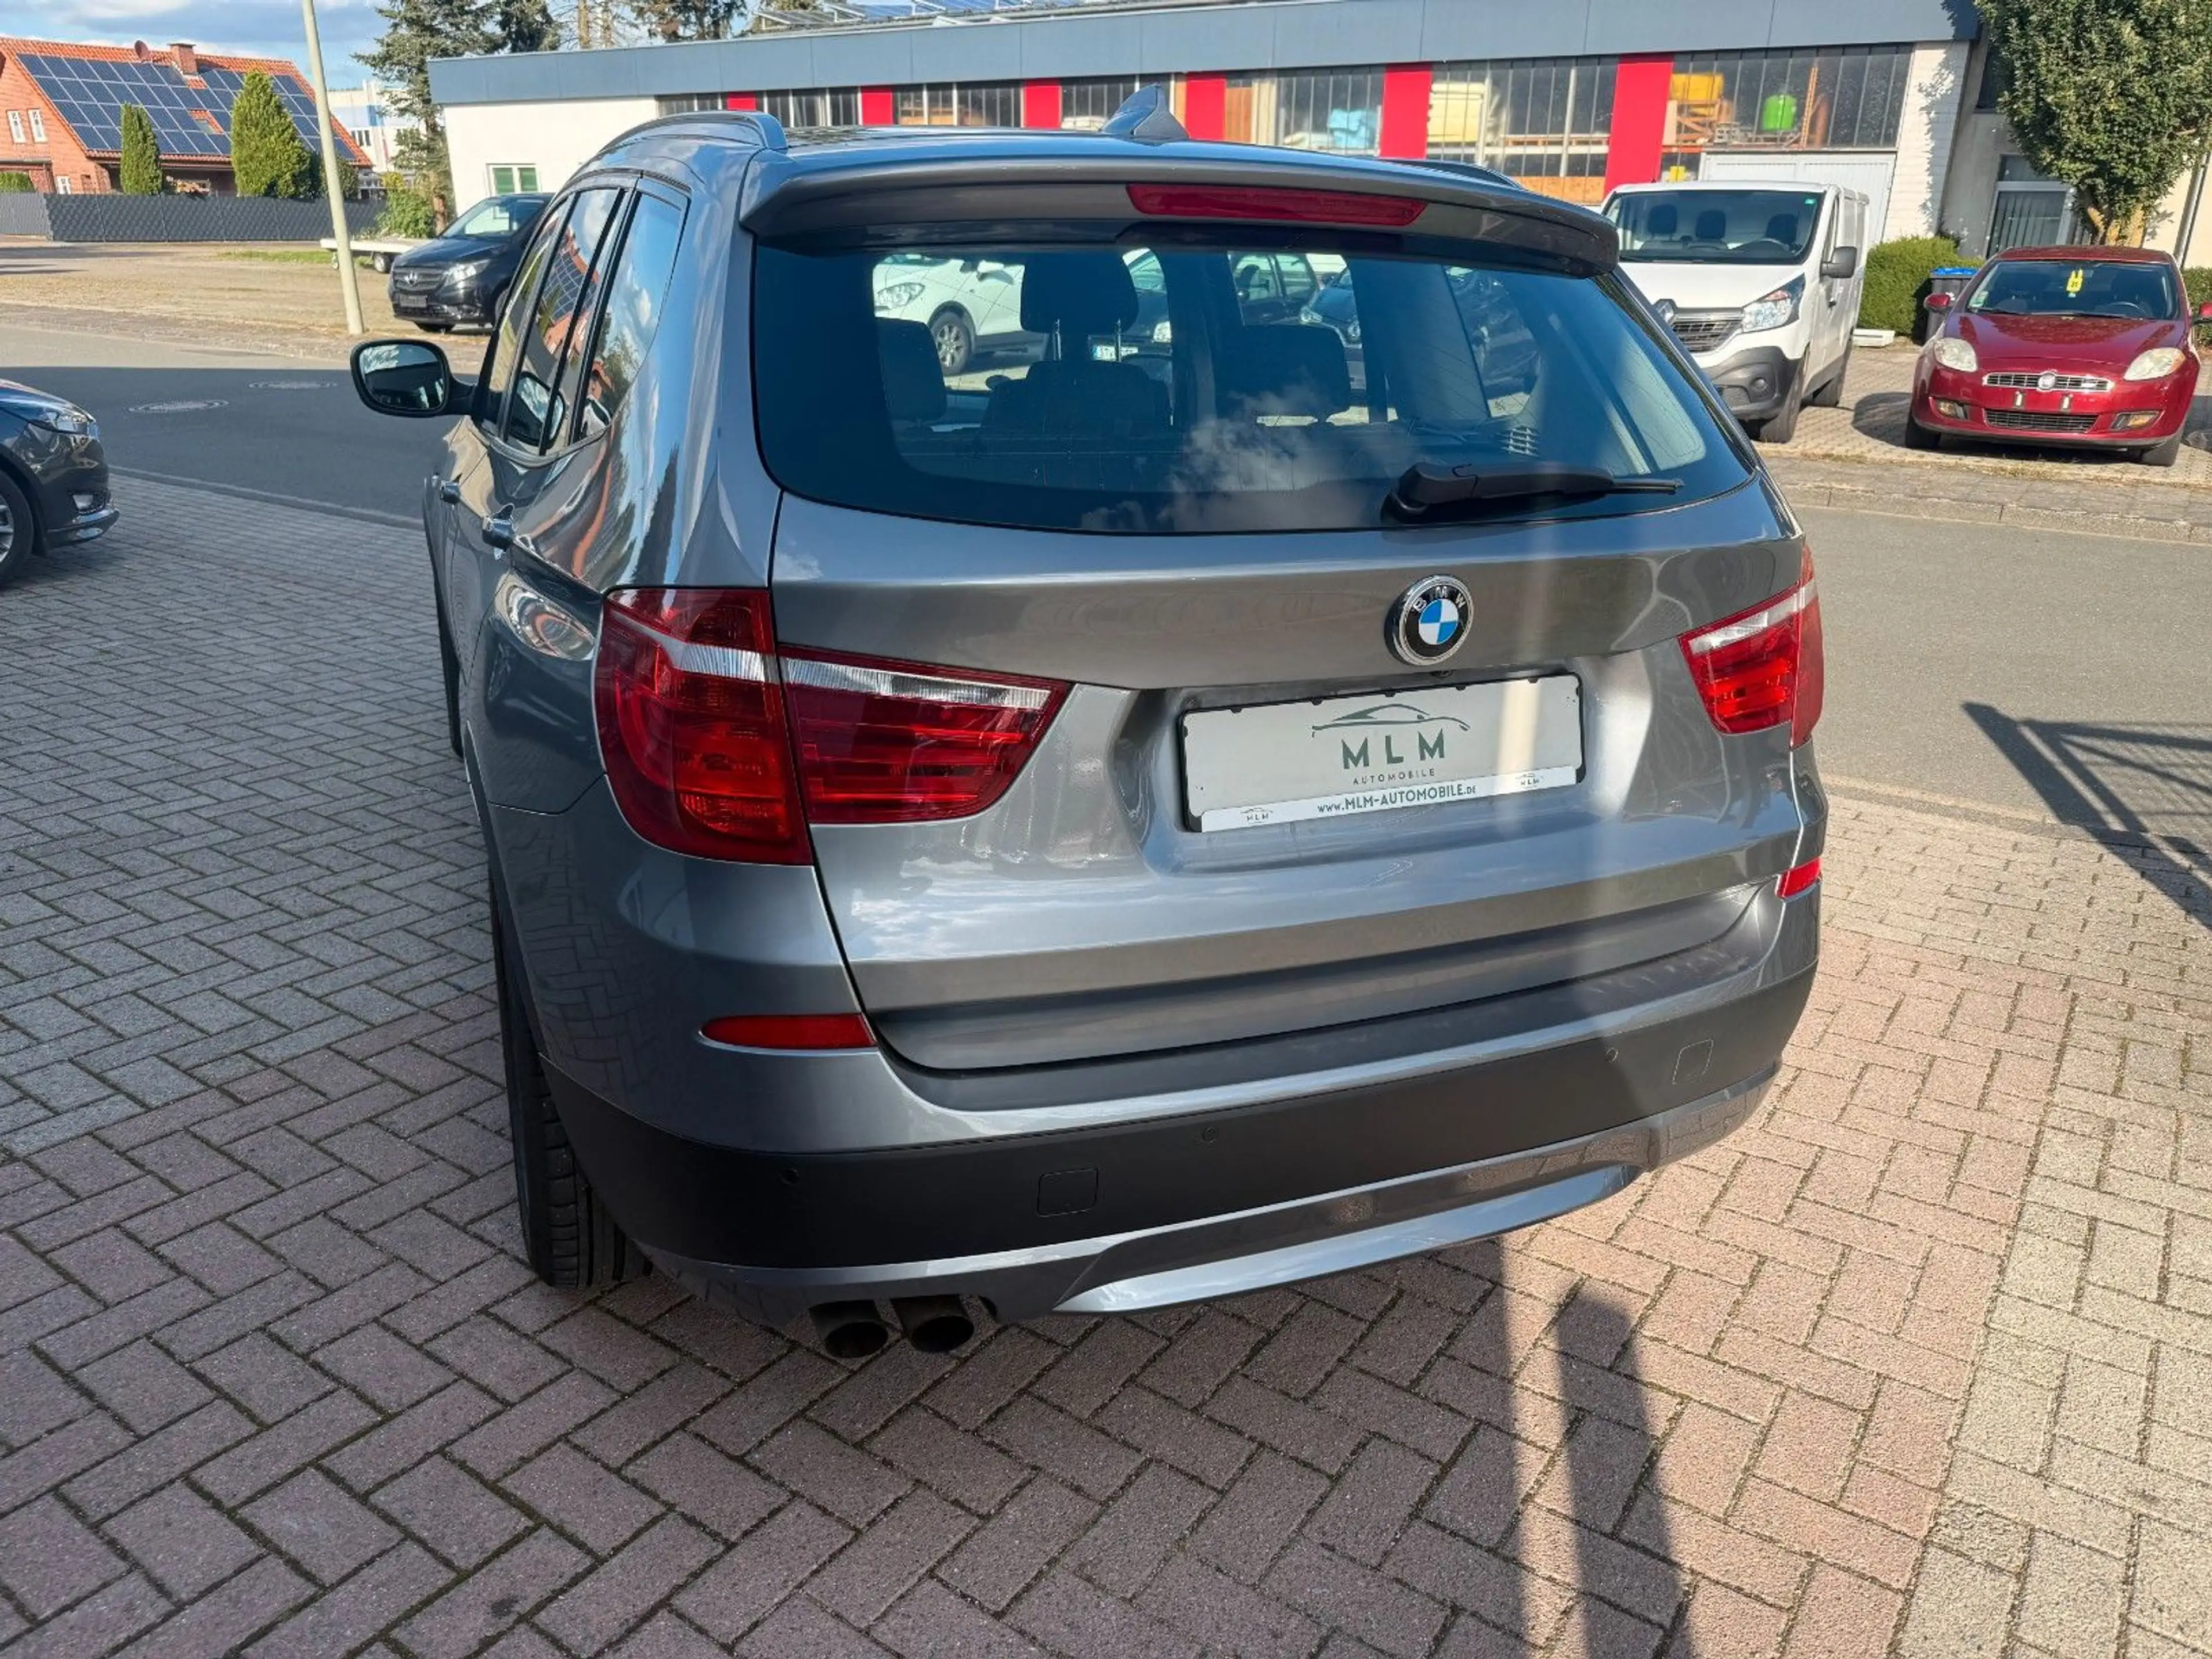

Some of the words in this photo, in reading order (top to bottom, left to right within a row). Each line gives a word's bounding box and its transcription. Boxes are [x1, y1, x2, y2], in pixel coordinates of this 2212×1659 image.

[1412, 586, 1467, 613] BMW
[1341, 728, 1445, 770] MLM
[1353, 768, 1435, 785] AUTOMOBILE
